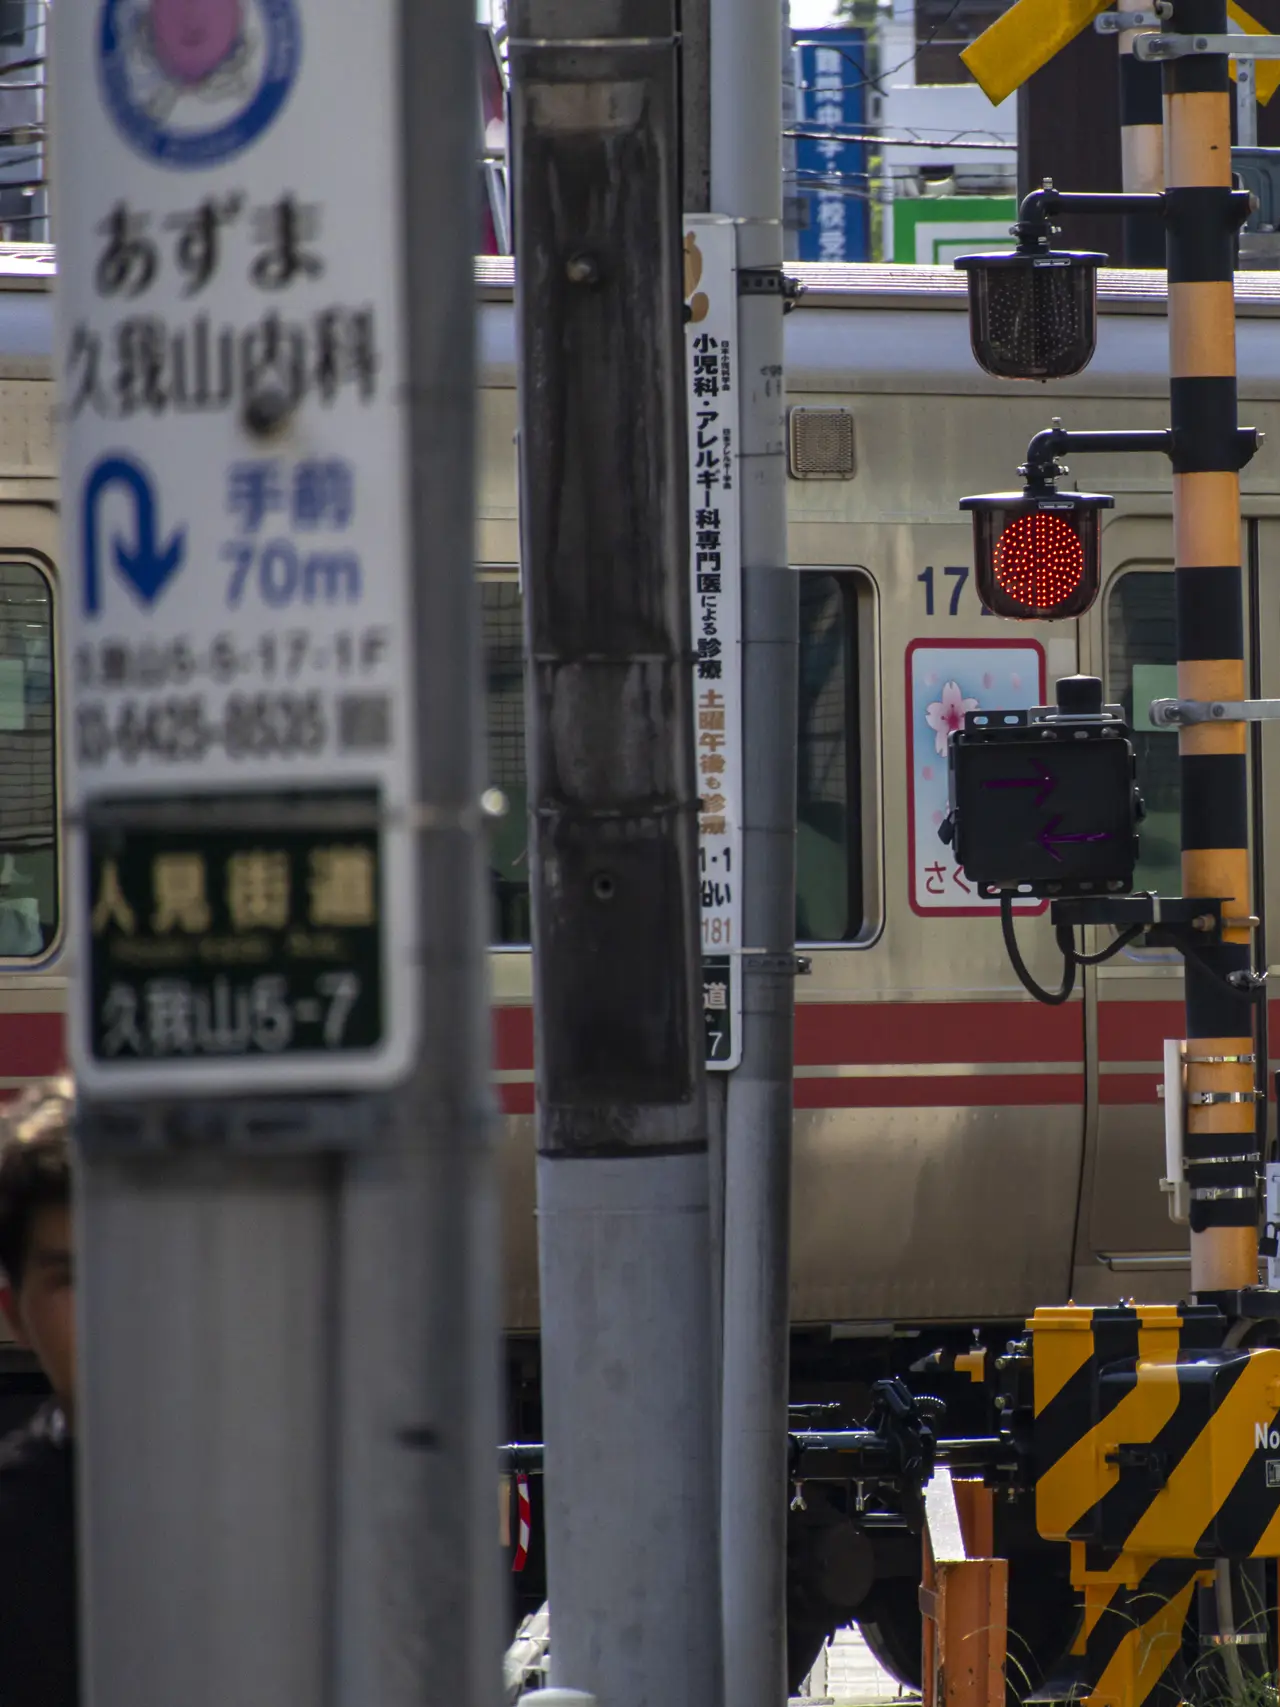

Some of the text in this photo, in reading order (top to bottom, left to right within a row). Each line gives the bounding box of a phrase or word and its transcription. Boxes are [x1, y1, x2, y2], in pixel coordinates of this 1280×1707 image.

[93, 190, 328, 298] あずま
[64, 308, 378, 420] 久我山内科
[227, 457, 354, 533] 手前
[692, 333, 722, 679] 小児科・アレルギー科専門医による診療
[220, 537, 363, 608] 70m
[917, 566, 995, 616] 17
[94, 846, 374, 934] 人見街道
[924, 861, 998, 894] さく
[103, 973, 362, 1055] 久我山5-7
[702, 982, 727, 1009] 道
